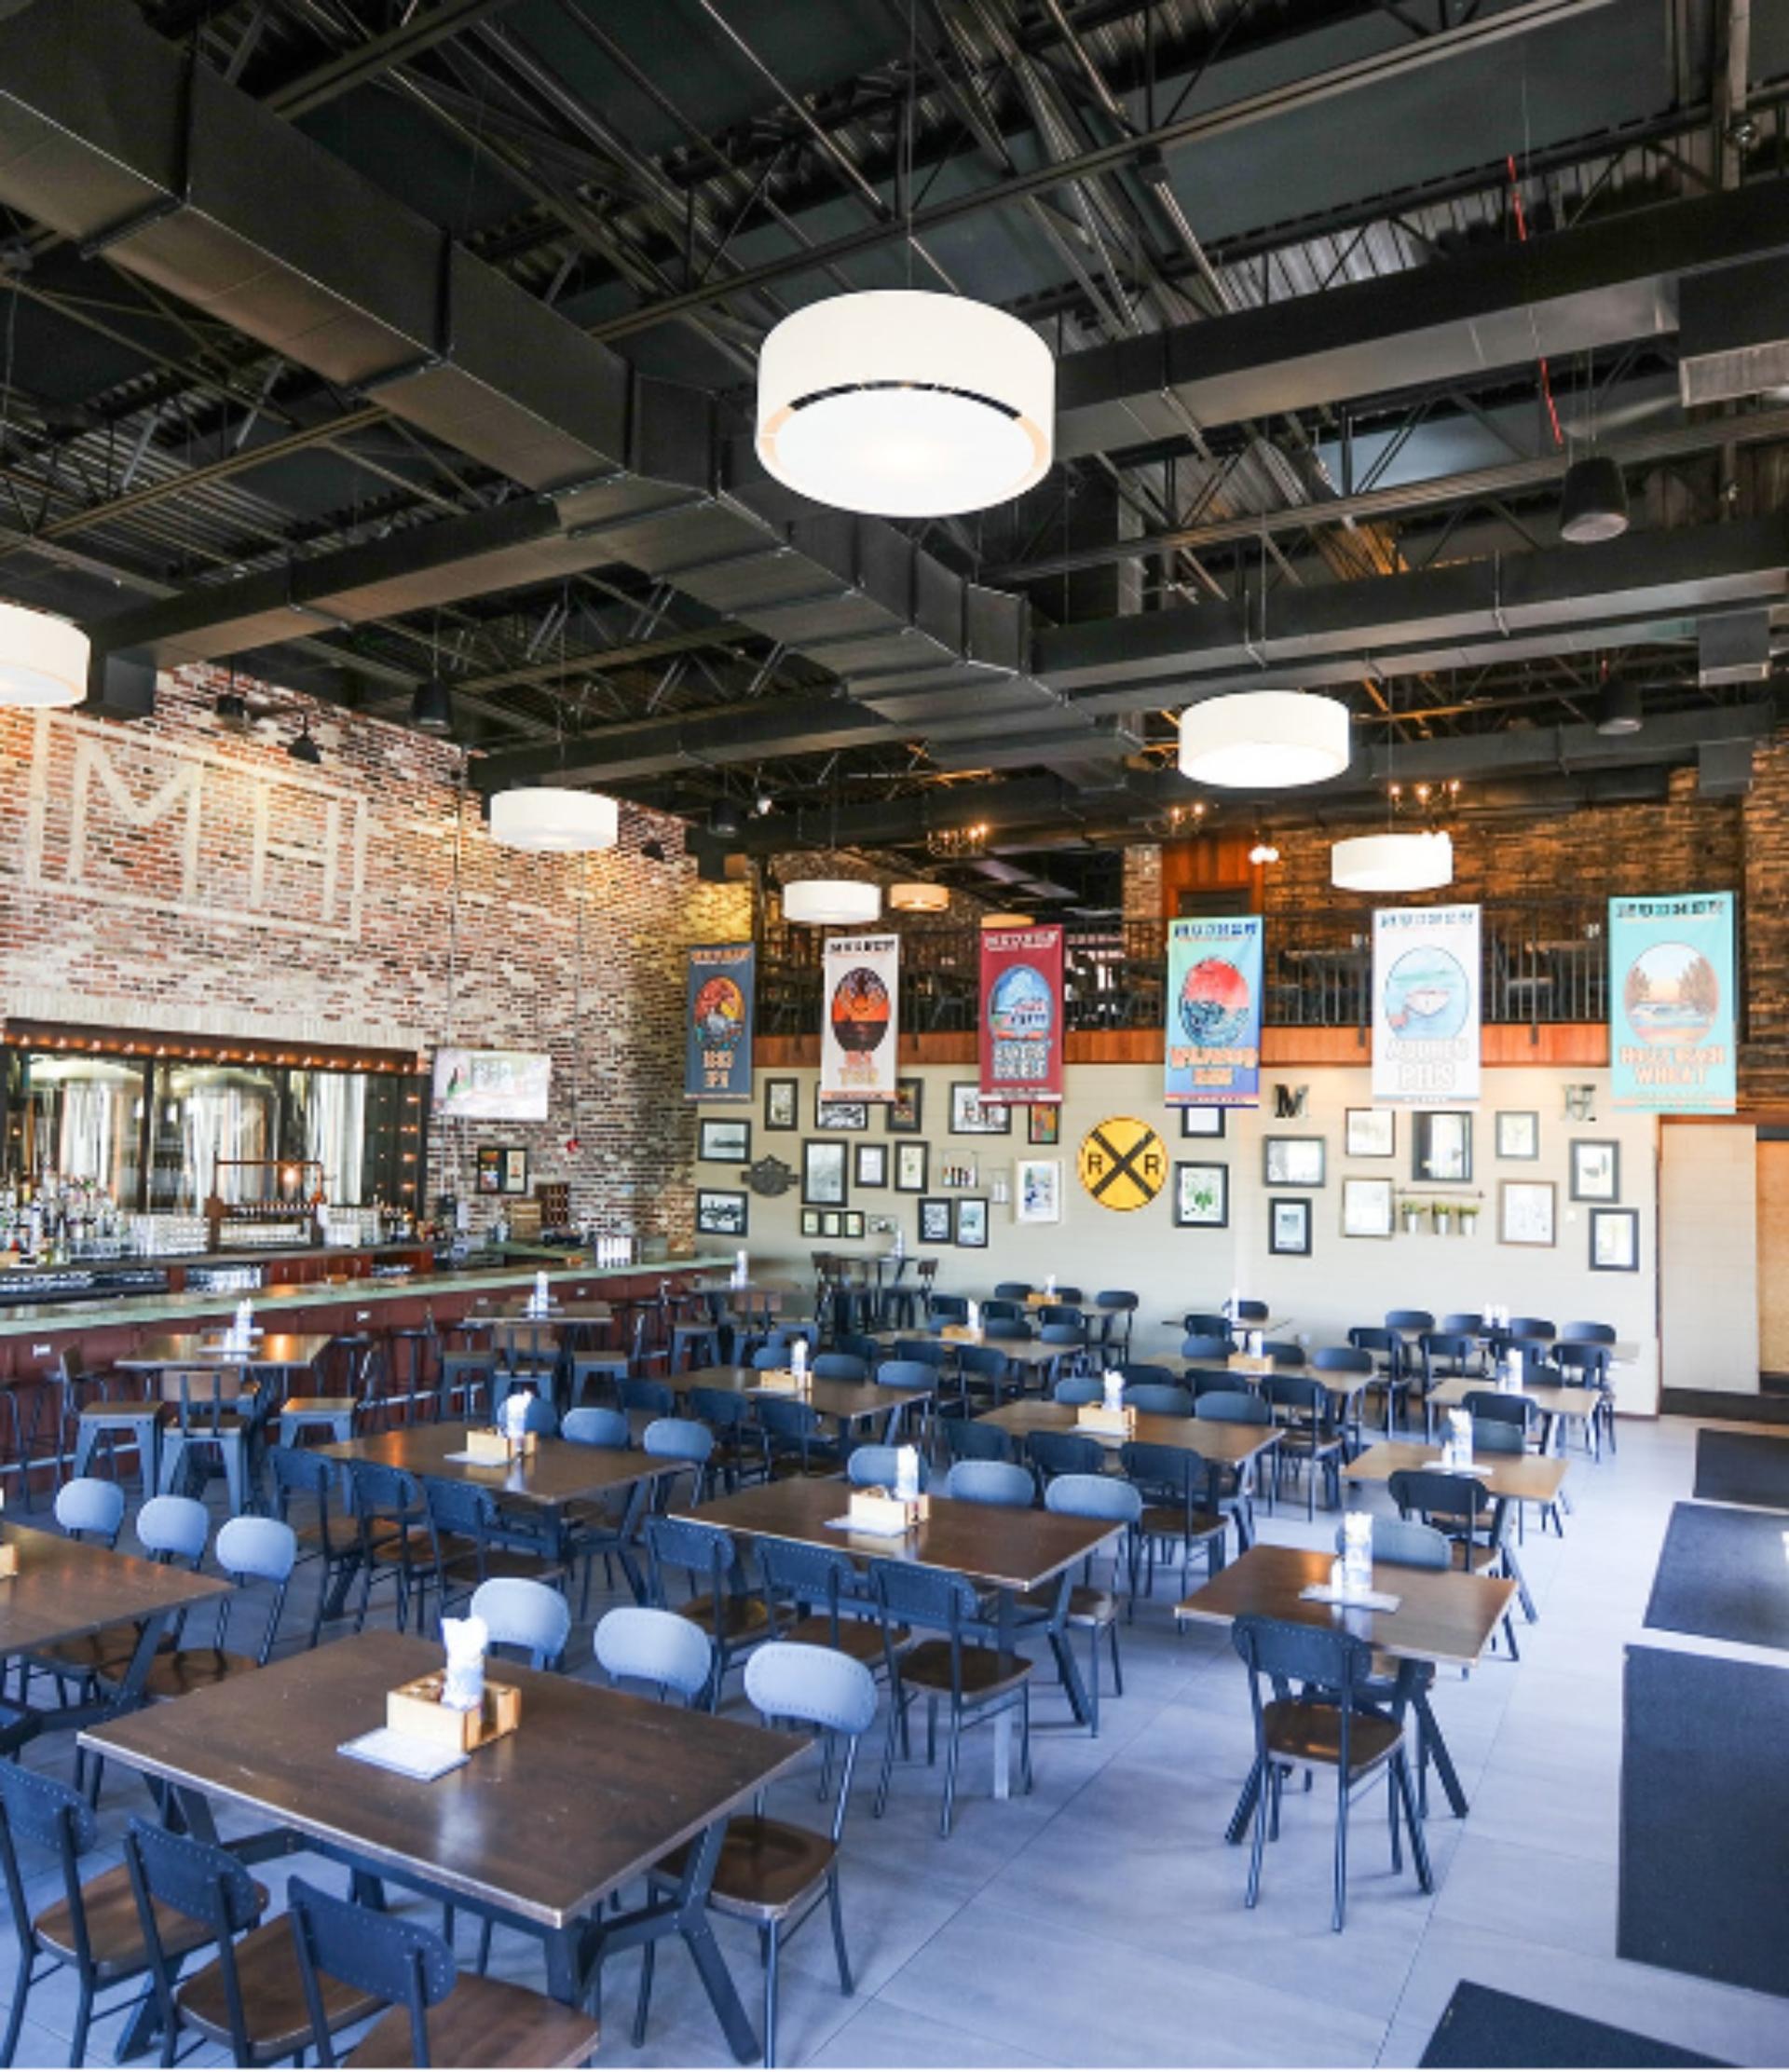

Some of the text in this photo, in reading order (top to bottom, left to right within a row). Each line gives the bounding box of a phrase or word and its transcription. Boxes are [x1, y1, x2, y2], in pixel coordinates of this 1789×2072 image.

[1381, 909, 1473, 928] MUDHEN
[1175, 922, 1257, 937] MUDHEN
[1400, 1062, 1455, 1091] PILS
[1635, 1066, 1707, 1086] WHEAT
[1275, 1084, 1310, 1118] M
